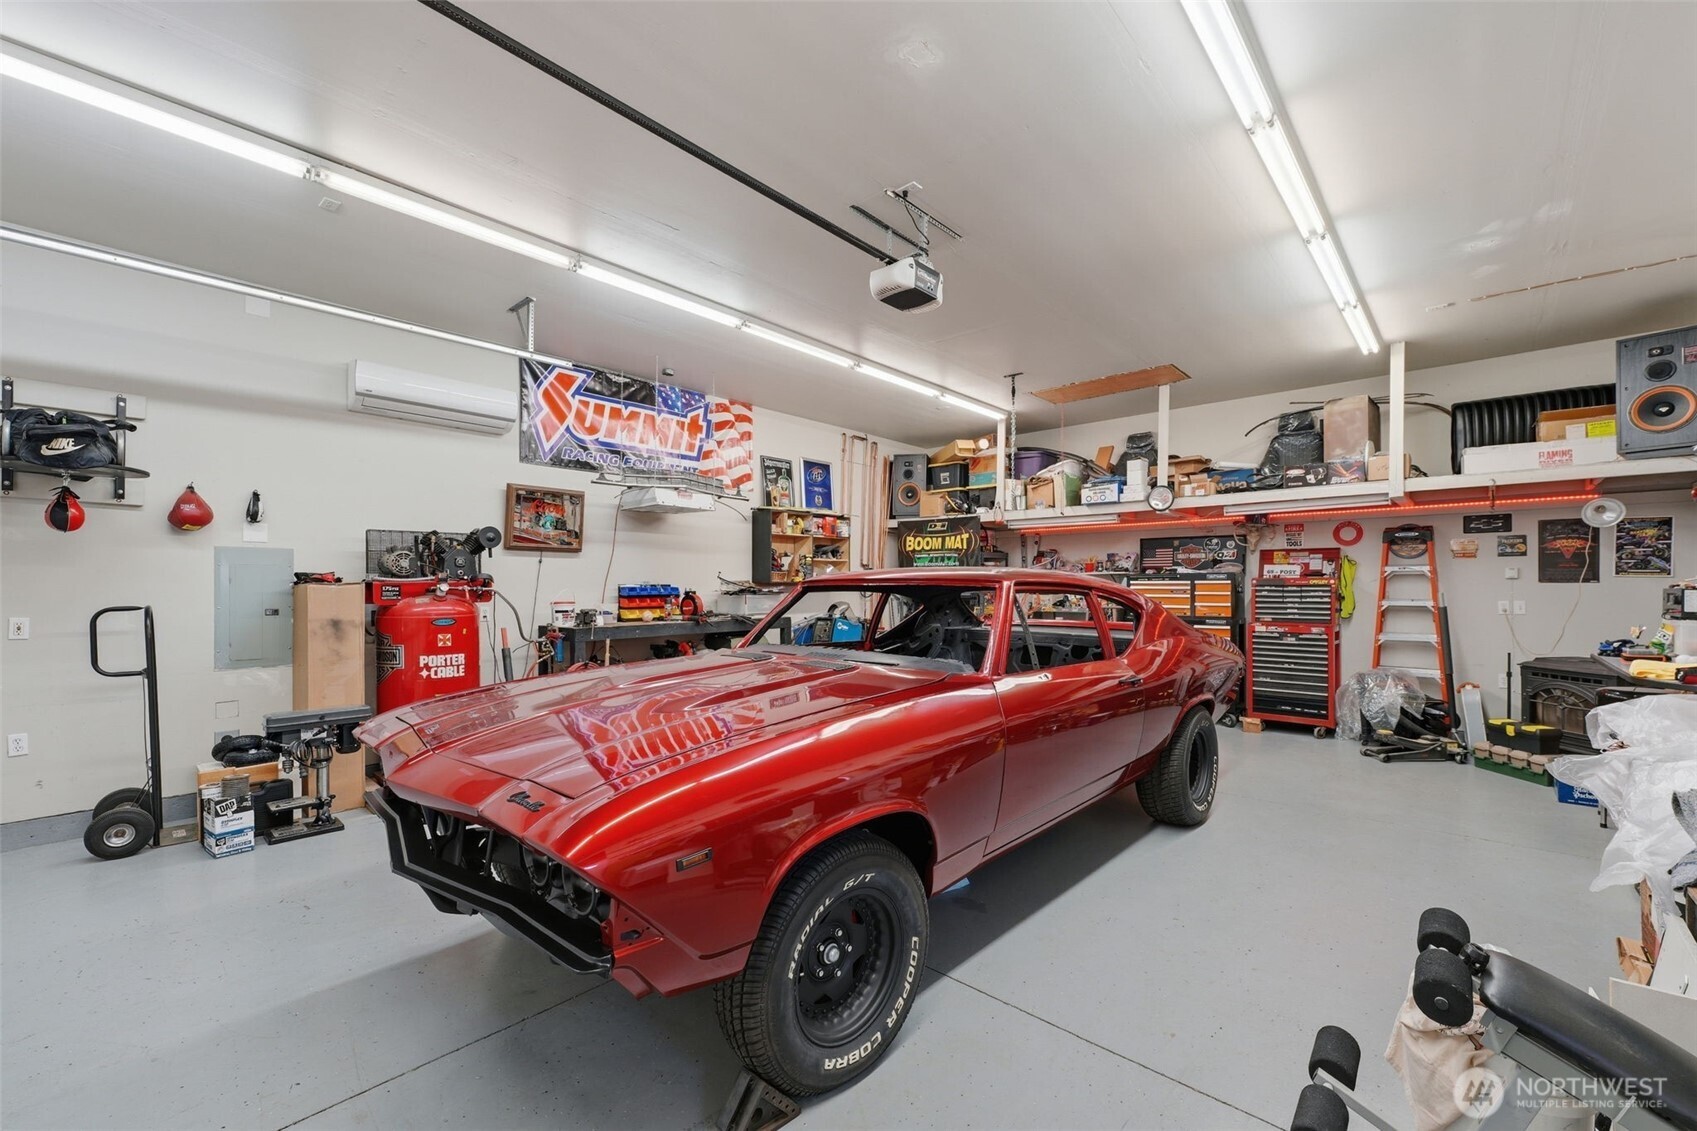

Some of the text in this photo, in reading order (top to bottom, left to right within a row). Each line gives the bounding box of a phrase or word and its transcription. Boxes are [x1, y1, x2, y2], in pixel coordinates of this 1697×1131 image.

[47, 437, 75, 449] NIKE
[562, 446, 699, 473] RACING EQUIPNT
[905, 533, 969, 551] BOOM MAT
[419, 653, 465, 667] PORTER
[219, 800, 235, 813] DAP
[843, 872, 875, 891] G/T
[787, 896, 834, 980] RADIAL
[886, 936, 920, 1028] COOPER
[824, 1031, 882, 1071] COBRA
